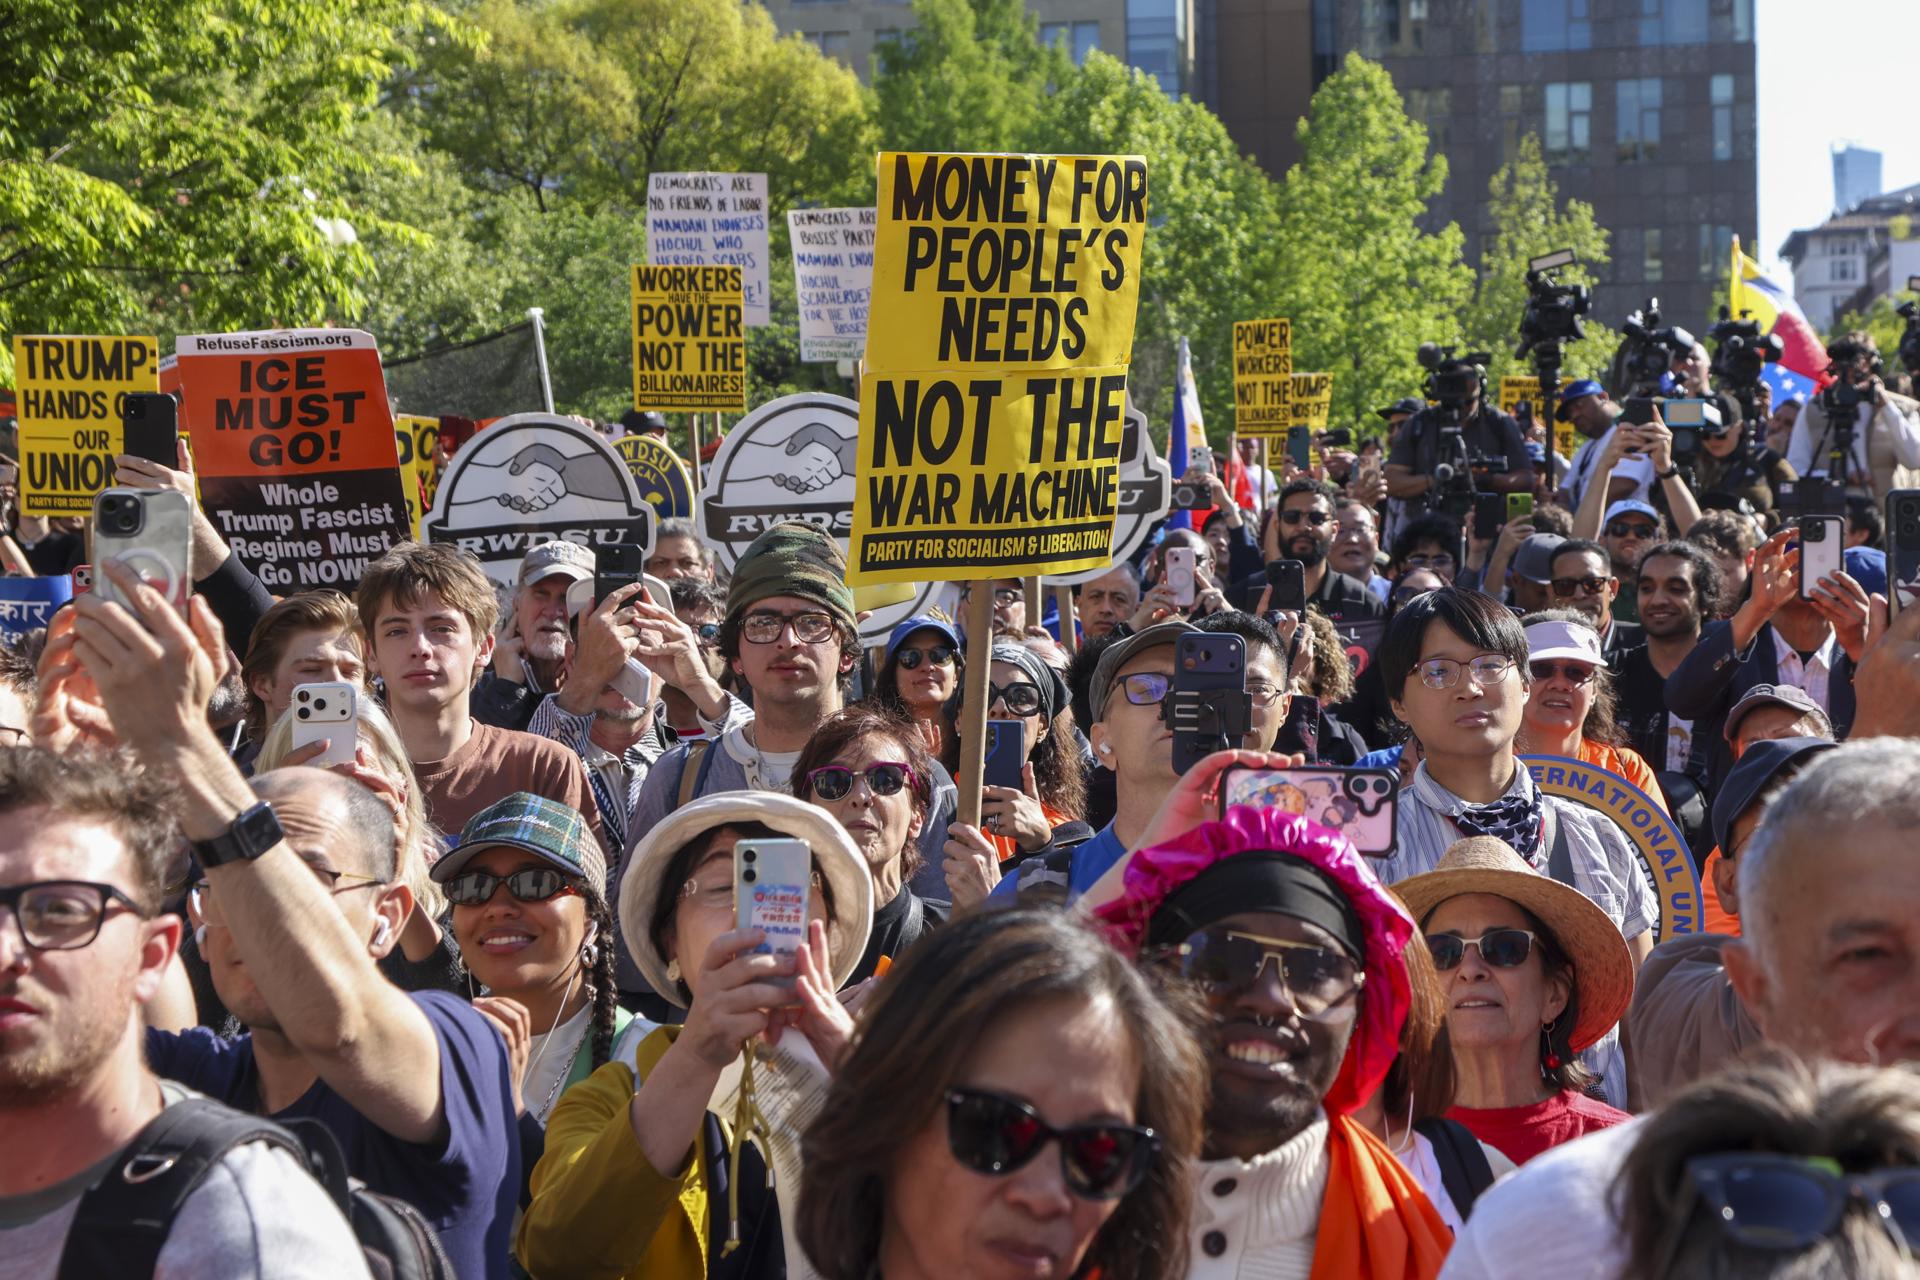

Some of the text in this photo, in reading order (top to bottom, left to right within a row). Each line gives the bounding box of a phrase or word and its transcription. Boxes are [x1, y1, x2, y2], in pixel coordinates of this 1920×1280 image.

[655, 176, 753, 192] DEMOCRATS ARE
[892, 154, 1147, 224] MONEY FOR
[649, 195, 763, 212] NO FRIENDS OF LABOR
[652, 214, 764, 233] MAMDANI ENDORSES
[793, 211, 876, 226] DEMOCRATS ARE
[655, 235, 743, 252] HOCHUL WHO
[843, 229, 875, 246] PARTY
[655, 252, 756, 269] HERDED SCABS
[796, 252, 843, 268] MAMDANI
[904, 226, 1129, 293] PEOPLE'S
[637, 266, 742, 292] WORKERS
[801, 275, 840, 289] HOCHUL
[667, 293, 710, 304] HAVE THE
[637, 304, 742, 338] POWER
[804, 306, 868, 322] FOR THE HOS
[938, 296, 1088, 362] NEEDS
[1236, 322, 1289, 351] POWER
[196, 334, 353, 351] RefuseFascism.org
[21, 338, 157, 381] TRUMP:
[638, 341, 743, 372] NOT THE
[1237, 354, 1290, 375] WORKERS
[240, 356, 326, 393] ICE
[639, 374, 744, 393] BILLIONAIRES!
[1292, 376, 1332, 398] RUMP:
[23, 388, 108, 420] HANDS
[640, 396, 659, 405] PARTY
[660, 396, 672, 405] FOR
[671, 396, 703, 405] SOCIALISM
[709, 397, 743, 406] LIBERATION
[1237, 381, 1290, 406] NOT THE
[215, 391, 366, 431] MUST
[872, 374, 1126, 469] NOT THE
[1292, 402, 1310, 418] NDS
[73, 429, 110, 450] OUR
[249, 430, 342, 467] GO!
[621, 441, 673, 472] WDSU
[26, 452, 119, 492] UNION
[629, 465, 657, 485] OCAL
[29, 496, 94, 509] PARTY FOR SOCIAL
[259, 481, 340, 506] Whole
[869, 465, 1117, 529] WAR MACHINE
[216, 509, 294, 536] Trump
[301, 502, 395, 530] Fascist
[726, 510, 853, 533] RWDS
[229, 530, 392, 563] Regime Must
[456, 527, 628, 554] RWDSU
[866, 529, 1110, 564] PARTY FOR SOCIALISM & LIBERATION
[258, 562, 293, 585] Go
[1529, 765, 1692, 934] ERNATIONAL UN
